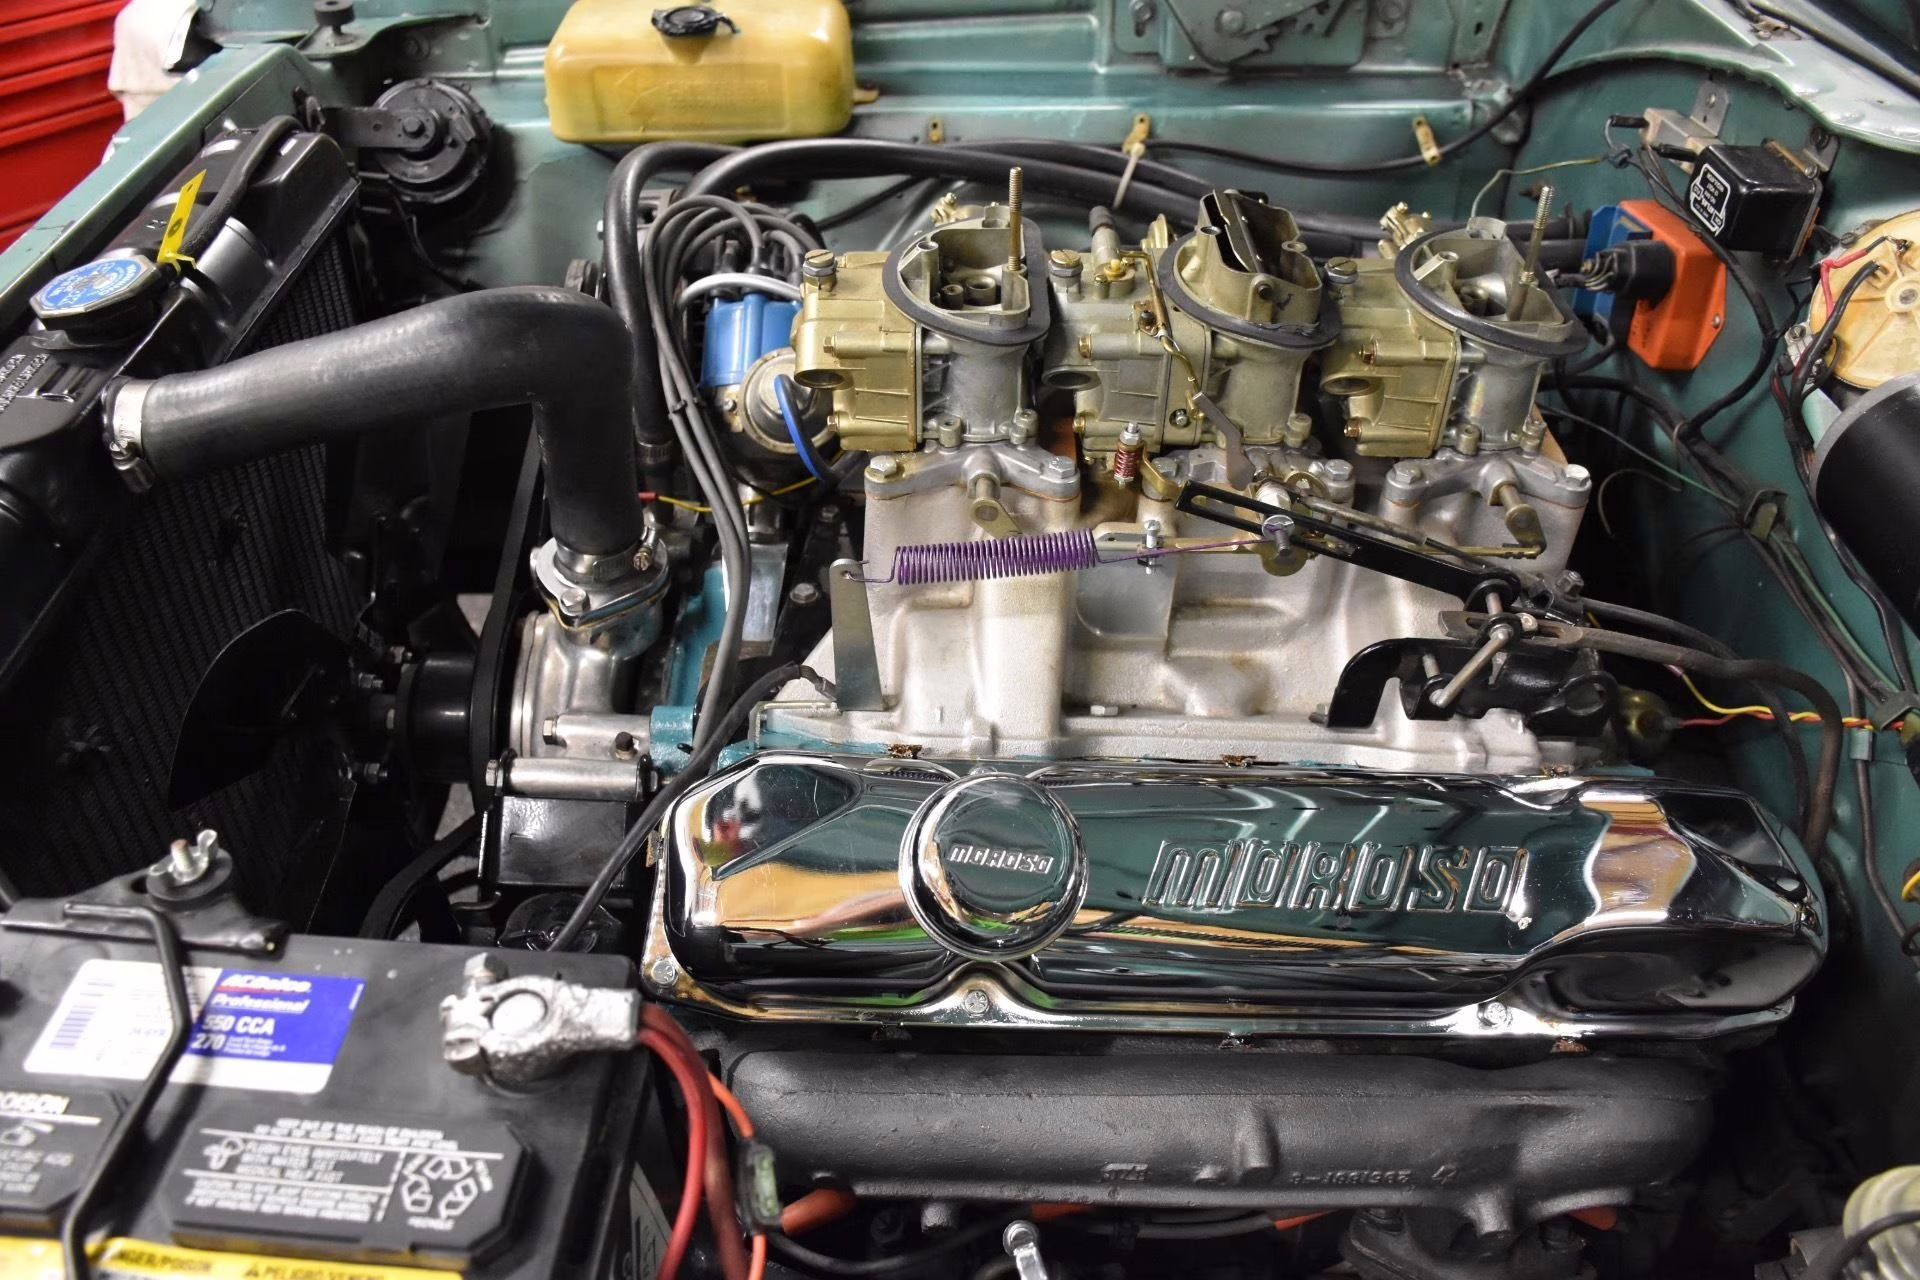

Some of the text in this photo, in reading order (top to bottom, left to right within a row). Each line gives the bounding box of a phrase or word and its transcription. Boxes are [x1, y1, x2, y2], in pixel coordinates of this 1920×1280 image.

[1141, 837, 1528, 914] MOROSO
[219, 974, 312, 993] ACDelco
[210, 993, 311, 1013] Professional
[202, 1014, 276, 1036] 550 CCA
[190, 1033, 227, 1050] 270
[0, 1091, 70, 1114] OISON
[241, 1153, 270, 1164] WITH
[312, 1159, 337, 1172] GET
[245, 1141, 384, 1164] FLUSH EYES IMMEDIATELY
[283, 1168, 315, 1180] HELP
[315, 1170, 344, 1183] FAST
